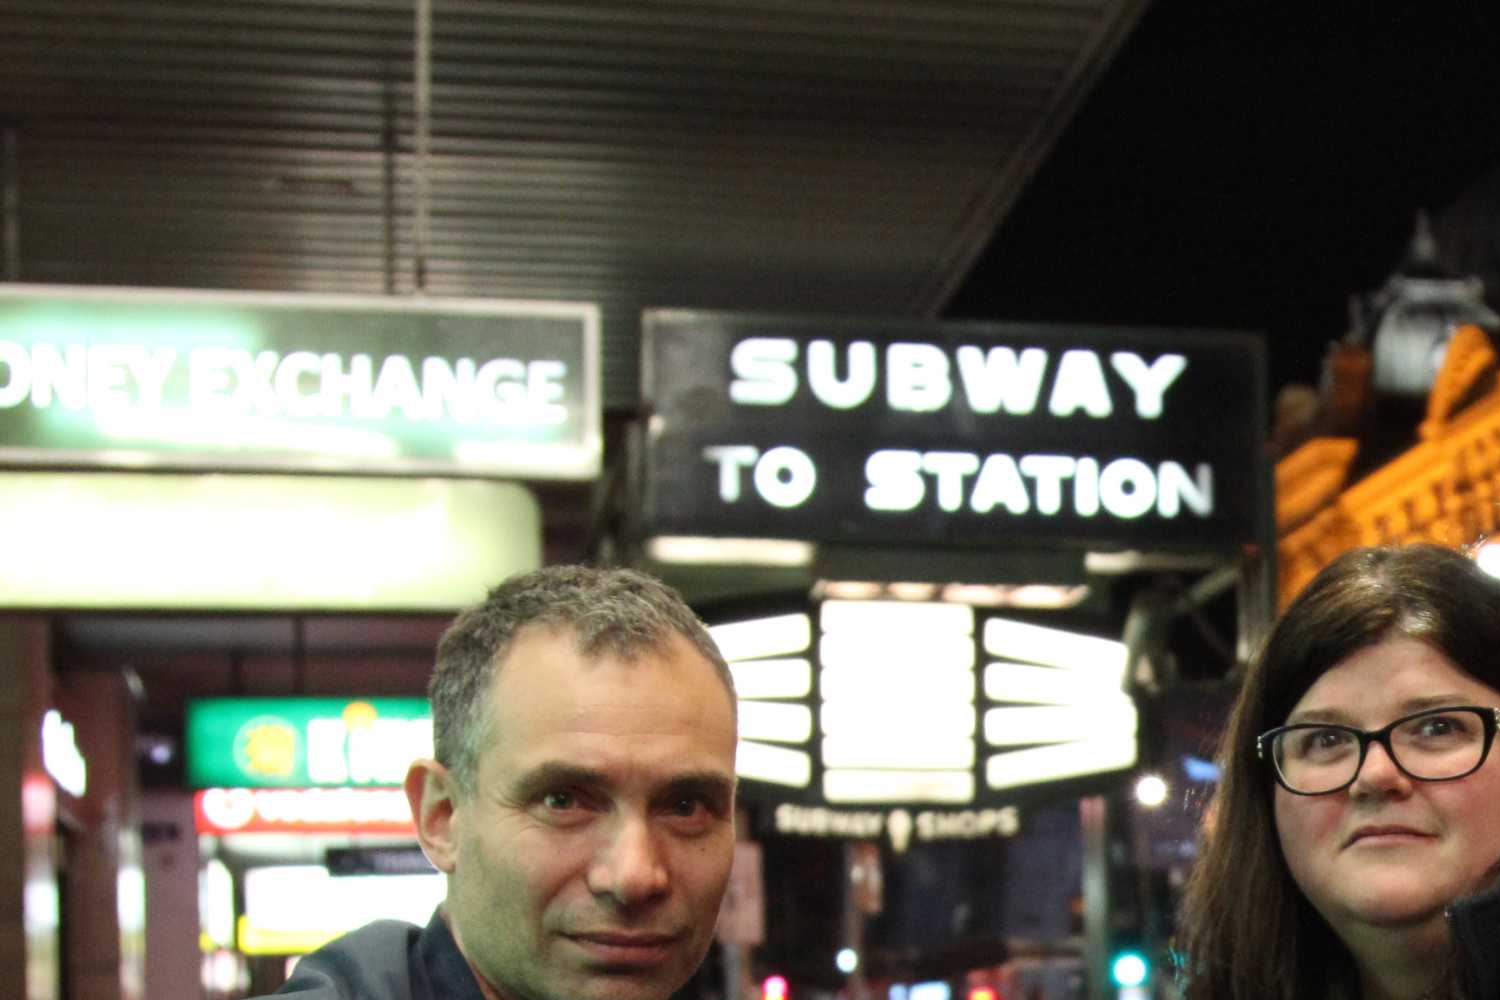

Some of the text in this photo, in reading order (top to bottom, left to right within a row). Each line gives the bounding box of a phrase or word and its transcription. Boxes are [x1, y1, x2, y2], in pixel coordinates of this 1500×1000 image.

[190, 348, 567, 423] EXCHANGE
[729, 337, 1186, 419] SUBWAY
[702, 444, 1214, 520] TO STATION
[915, 806, 1020, 841] SHOPS
